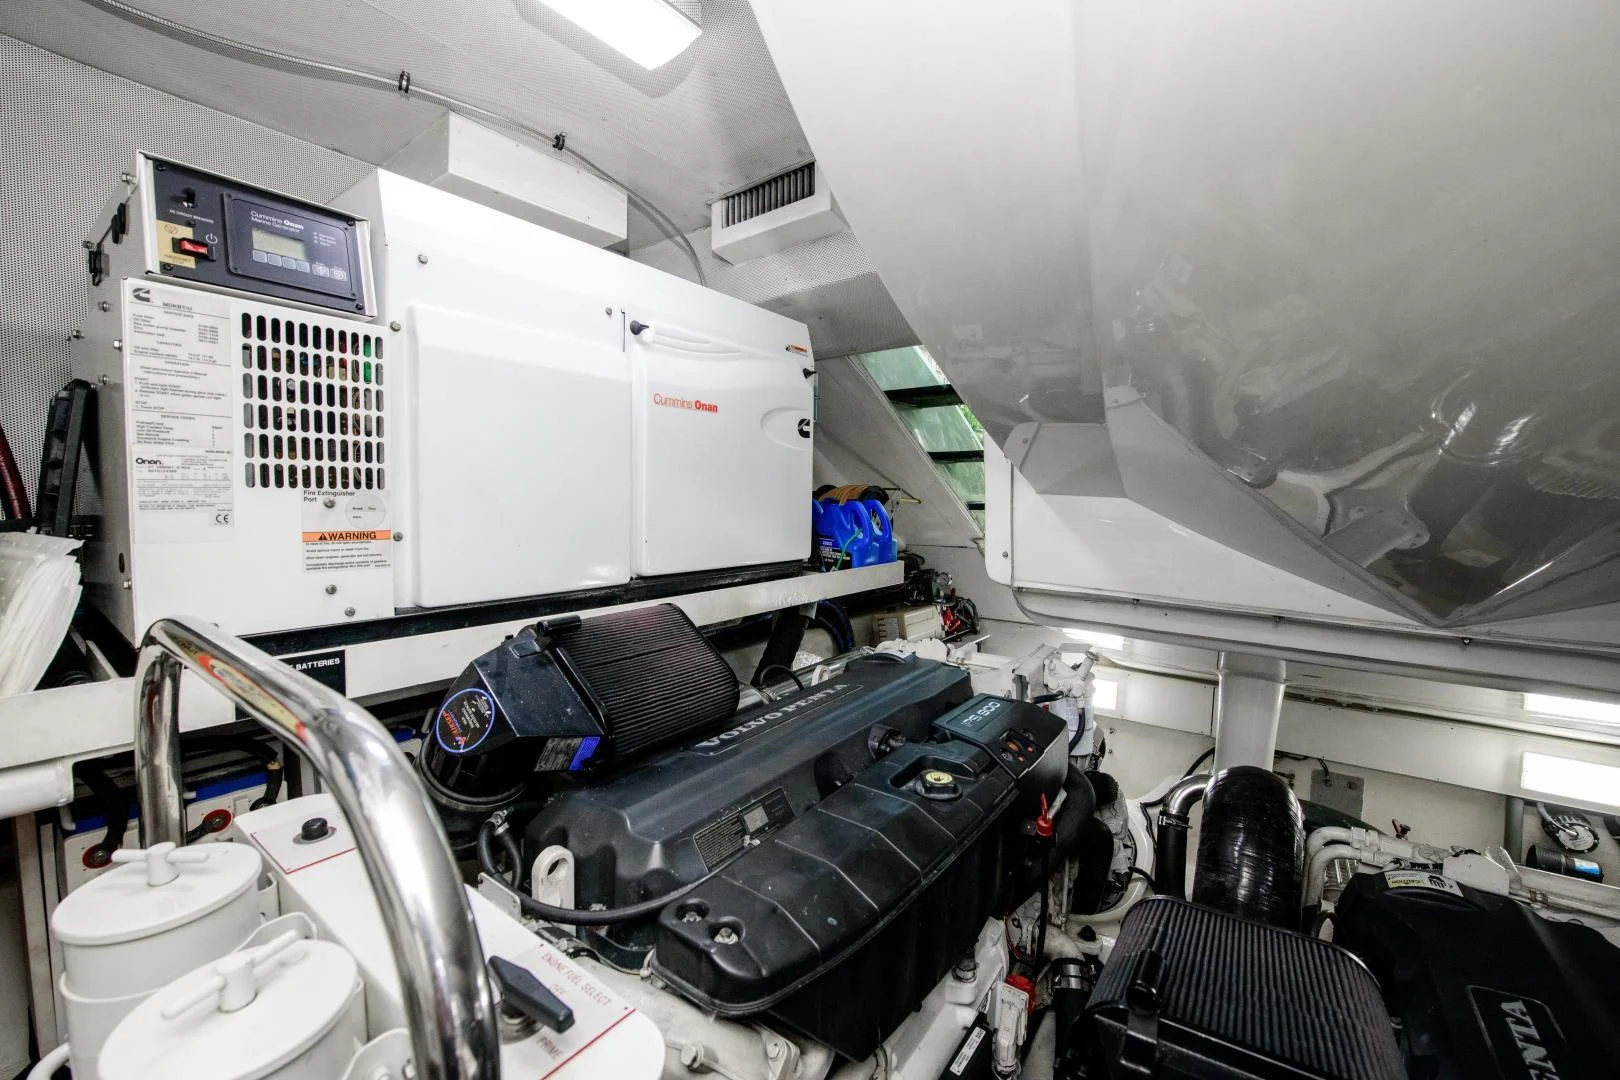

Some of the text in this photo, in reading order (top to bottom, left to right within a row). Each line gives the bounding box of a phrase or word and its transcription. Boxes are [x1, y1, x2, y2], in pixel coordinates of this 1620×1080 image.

[250, 210, 304, 230] Cummins Onan
[653, 392, 718, 413] Cummins Onan
[135, 457, 162, 465] Onan
[215, 513, 230, 524] CE
[328, 531, 377, 541] WARNING
[296, 657, 340, 670] BATTERIES
[977, 701, 1001, 716] 900
[695, 711, 783, 748] VOLVO
[580, 983, 612, 1006] SELECT
